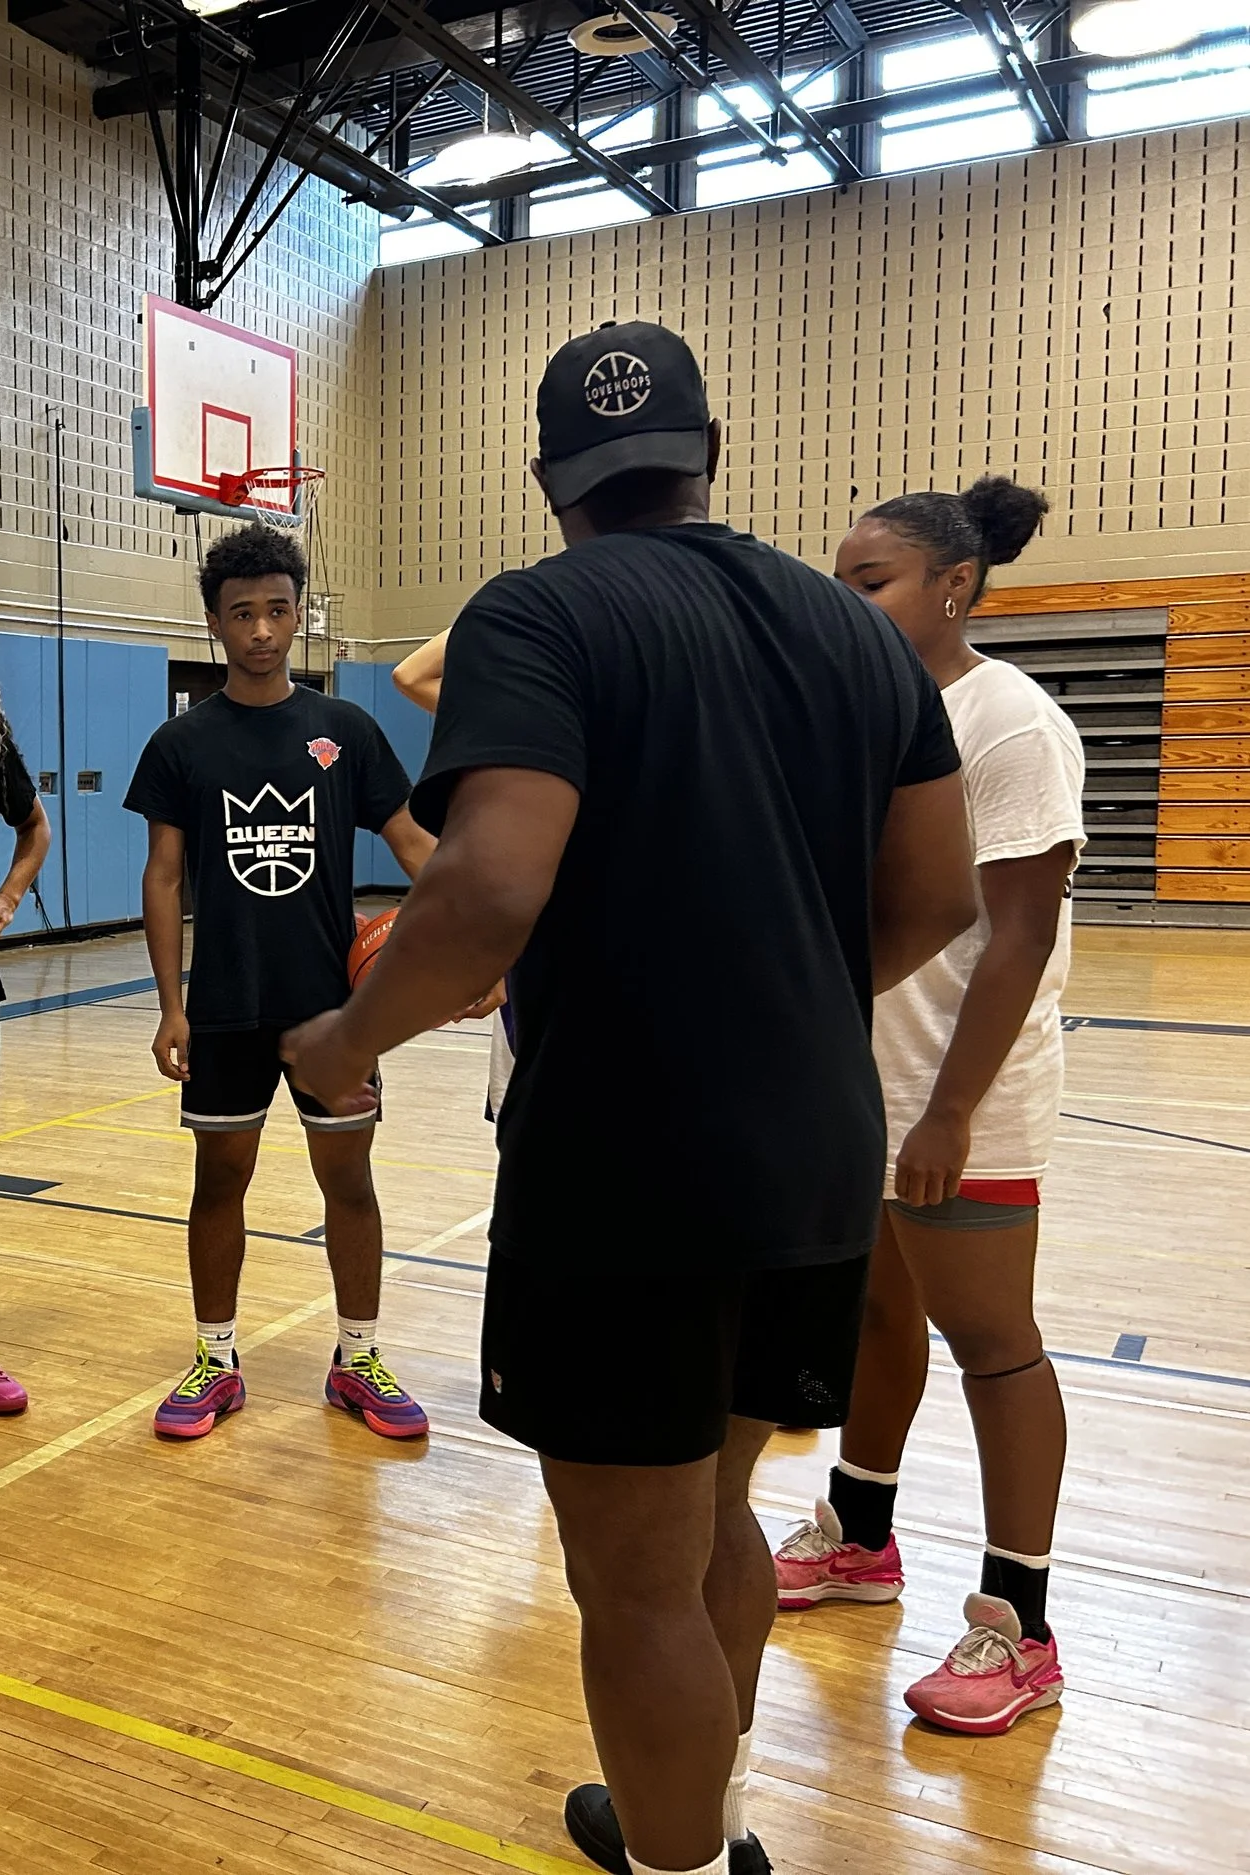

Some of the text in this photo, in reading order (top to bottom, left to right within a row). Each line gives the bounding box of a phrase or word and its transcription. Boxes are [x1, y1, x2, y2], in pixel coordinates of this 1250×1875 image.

[586, 375, 651, 402] LOVE HOOPS
[226, 825, 315, 844] QUEEN
[256, 844, 290, 858] ME
